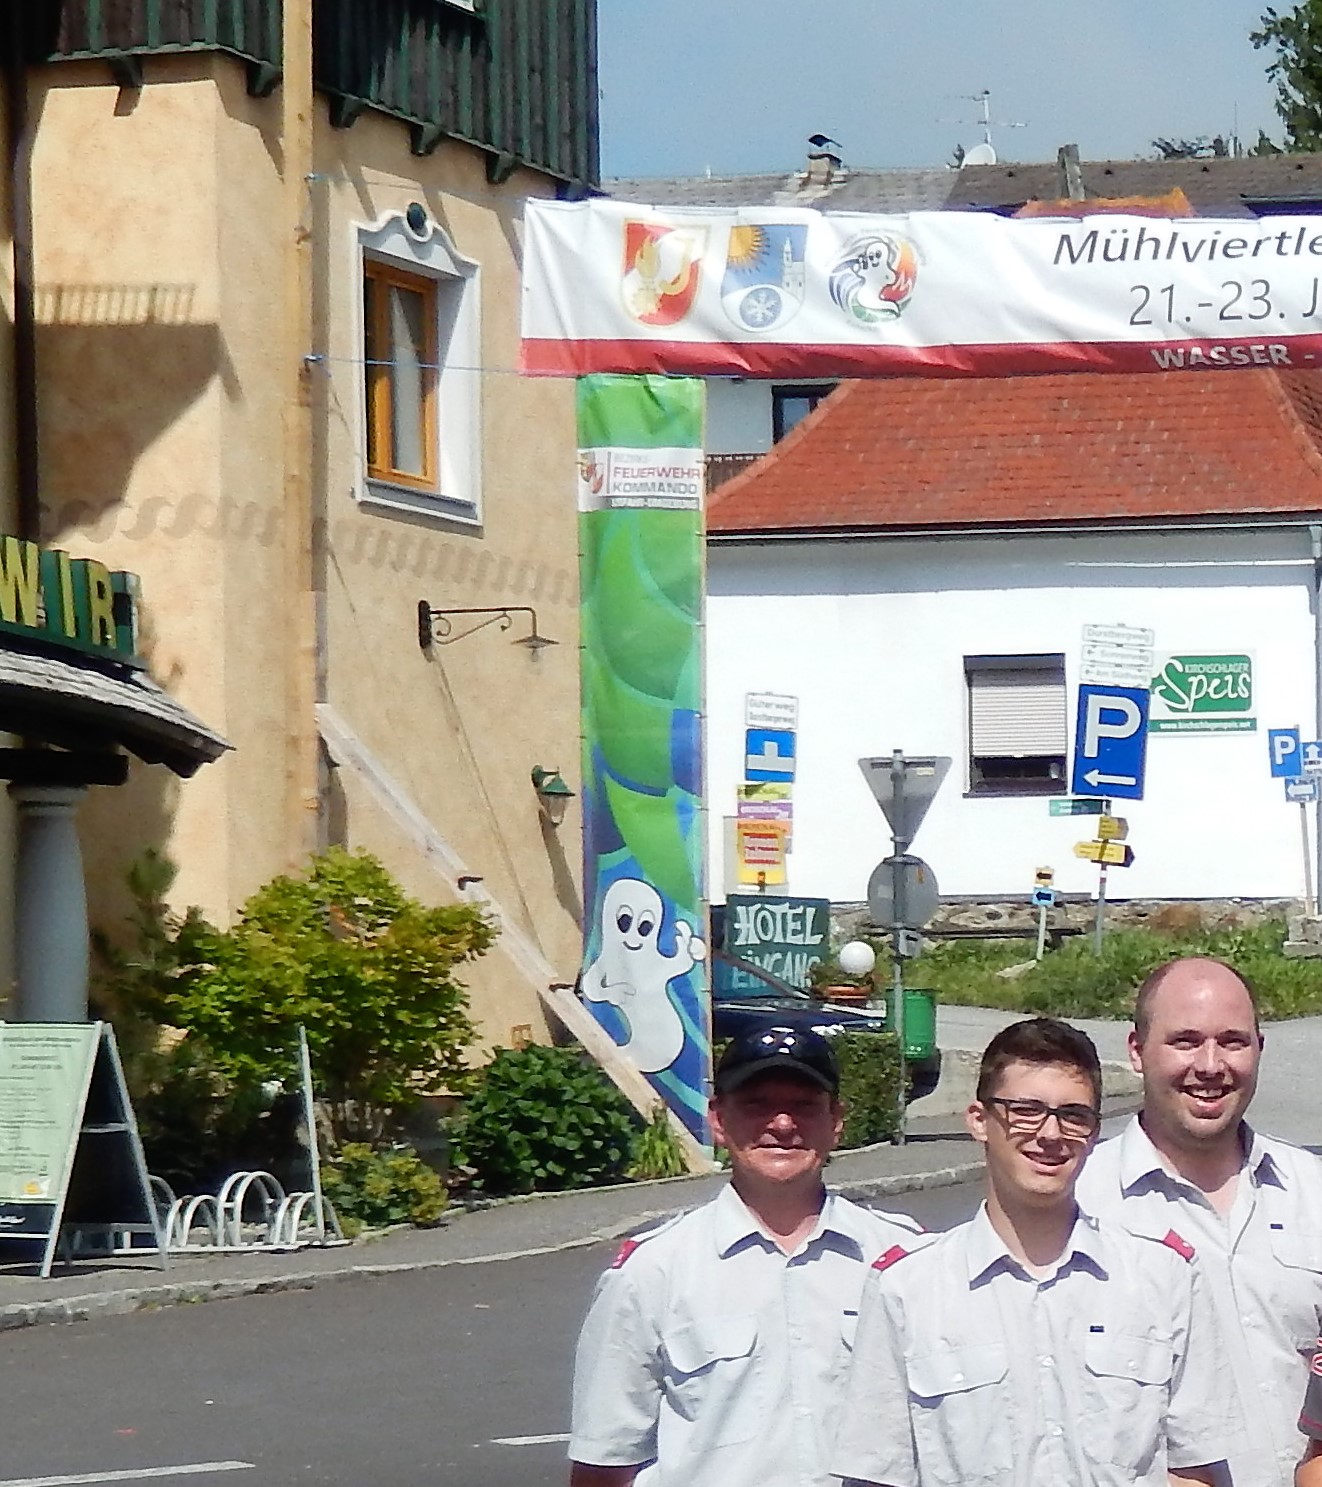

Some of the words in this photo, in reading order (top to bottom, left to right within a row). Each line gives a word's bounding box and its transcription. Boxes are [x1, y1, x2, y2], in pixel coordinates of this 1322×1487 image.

[1129, 279, 1285, 326] 21.-23.
[1151, 344, 1293, 370] WASSER
[613, 467, 700, 479] FEUERWEHR
[613, 482, 698, 494] KOMMANDO
[1155, 658, 1250, 712] Speis
[1084, 694, 1141, 757] P
[1273, 735, 1296, 764] P
[733, 901, 824, 946] HOTEL
